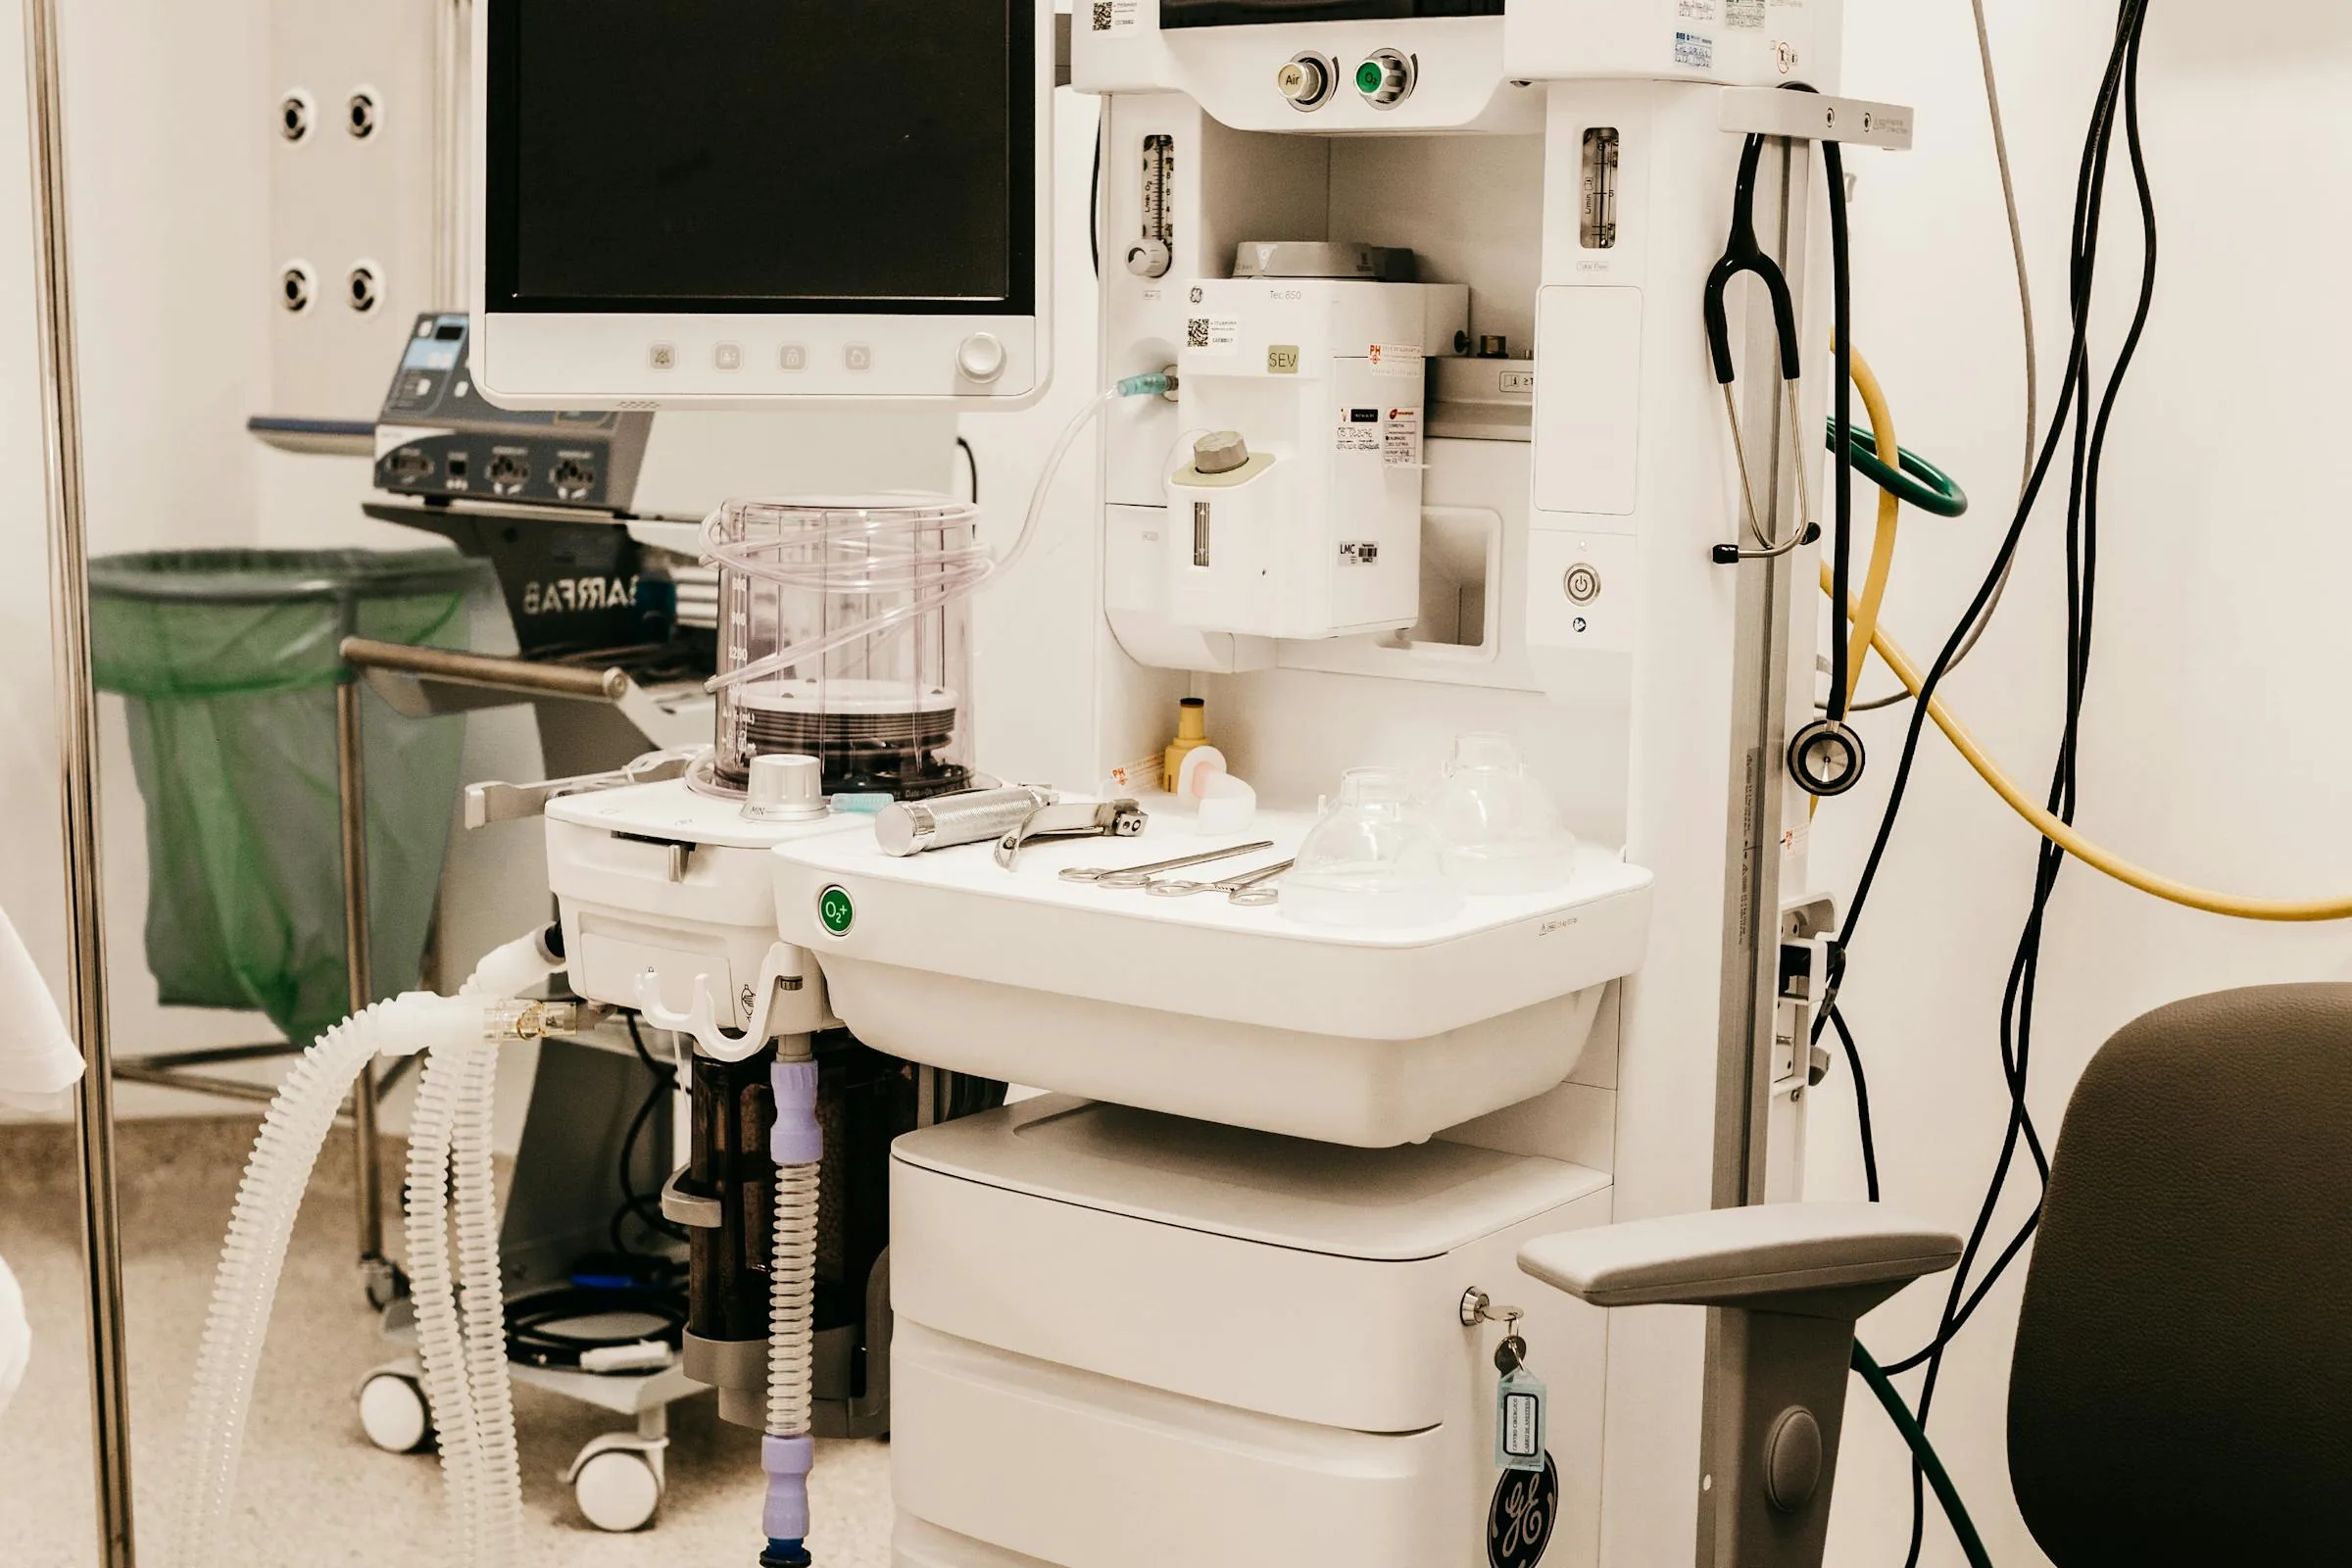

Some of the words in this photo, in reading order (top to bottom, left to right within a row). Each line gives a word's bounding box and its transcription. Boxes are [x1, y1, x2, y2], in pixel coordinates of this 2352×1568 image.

[1286, 74, 1300, 85] Air
[1270, 290, 1284, 300] Tec
[1285, 290, 1301, 300] 850
[1269, 352, 1297, 368] SEV
[1340, 543, 1355, 555] LMC
[750, 806, 765, 816] MIN
